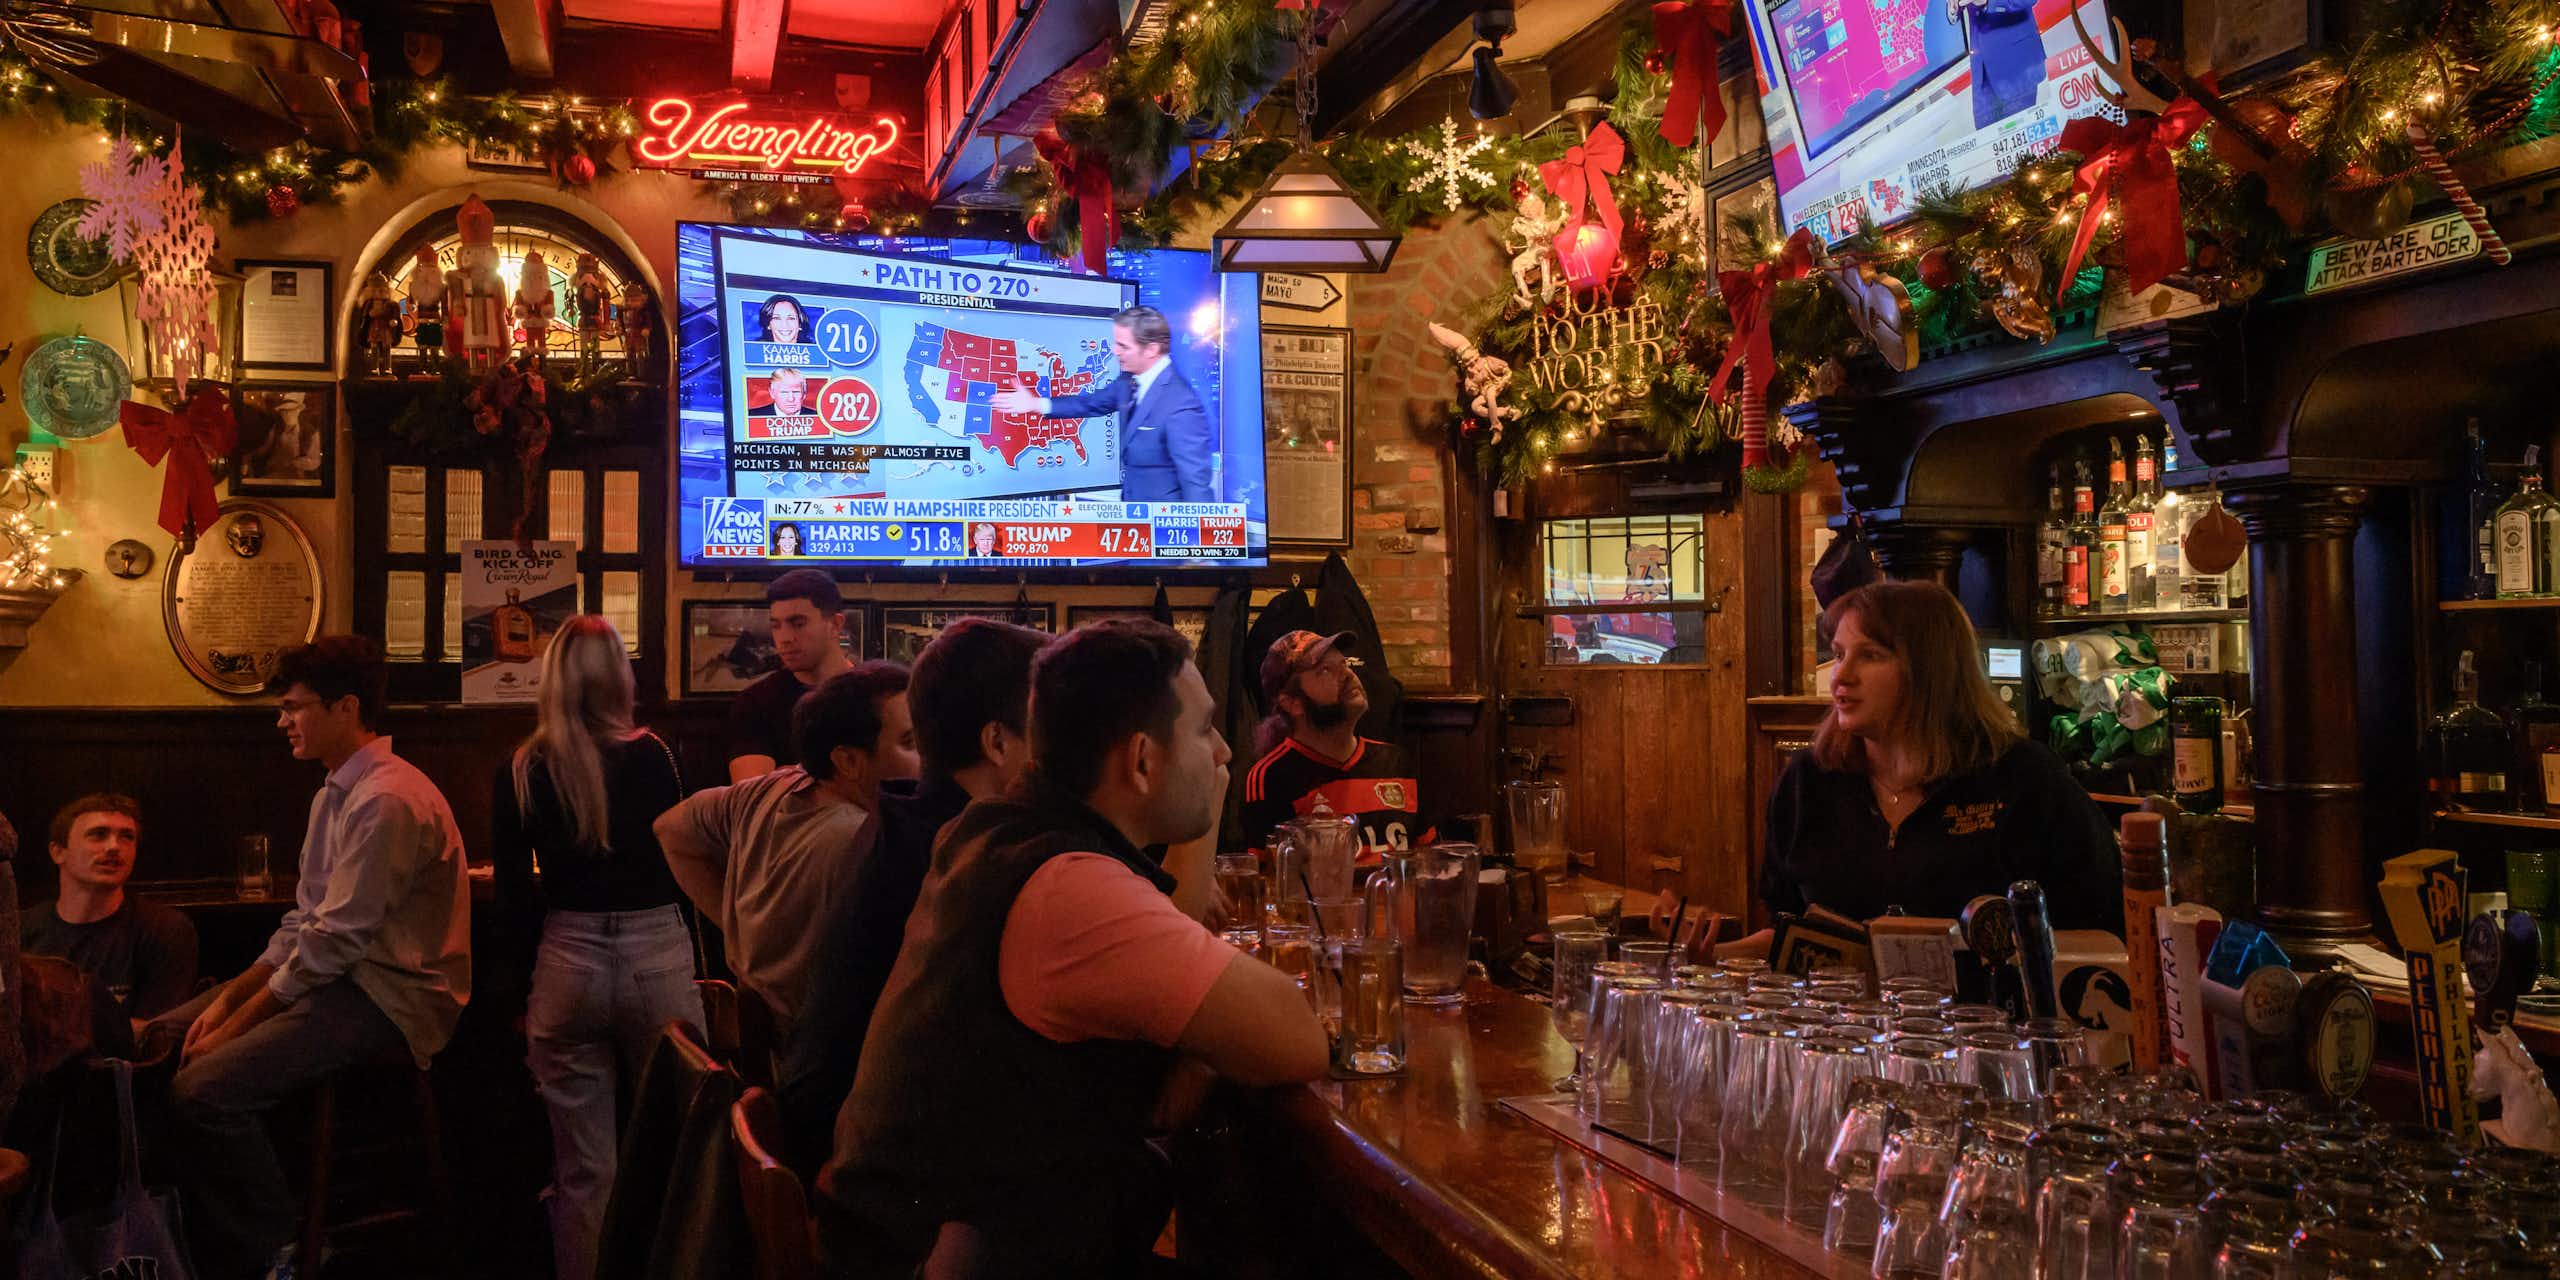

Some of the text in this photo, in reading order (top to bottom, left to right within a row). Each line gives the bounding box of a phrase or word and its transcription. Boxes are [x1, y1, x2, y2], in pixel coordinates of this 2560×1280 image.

[2058, 46, 2090, 70] LIVE
[2059, 67, 2101, 109] CNN
[640, 99, 897, 174] Yuengling
[1907, 148, 1947, 174] MINNESOTA
[704, 170, 819, 184] AMERICA'S OLDEST BREWERY
[1919, 163, 1950, 186] HARRIS
[1804, 198, 1834, 219] ELECTORAL
[1834, 191, 1848, 204] MAP
[2325, 218, 2462, 267] BEWARE OF
[2313, 235, 2471, 287] ATTACK BARTENDER
[876, 263, 1030, 298] PATH TO 270
[1266, 285, 1329, 299] MAYO 5
[919, 292, 996, 309] PRESIDENTIAL
[826, 322, 868, 354] 216
[1534, 303, 1664, 358] TO THE
[763, 344, 811, 356] KAMALA
[763, 354, 811, 366] HARRIS
[1295, 375, 1341, 387] CULTURE
[828, 393, 871, 422] 282
[765, 417, 815, 429] DONALD
[768, 427, 812, 437] TRUMP
[734, 444, 964, 459] MICHIGAN, HE WAS UP ALMOST FIVE
[734, 459, 870, 471] POINTS IN MICHIGAN
[850, 501, 887, 517] NEW
[893, 502, 986, 519] HAMPSHIRE
[989, 503, 1058, 518] PRESIDENT
[1078, 504, 1123, 512] ELECTORAL
[1096, 511, 1123, 519] VOTES
[1132, 505, 1141, 518] 4
[1170, 505, 1230, 515] PRESIDENT
[725, 511, 762, 528] FOX
[1156, 517, 1243, 528] HARRIS TRUMP
[713, 528, 764, 544] NEWS
[810, 525, 881, 542] HARRIS
[1006, 526, 1072, 543] TRUMP
[1167, 529, 1234, 545] 216 232
[474, 550, 512, 559] BIRD
[711, 546, 758, 556] LIVE
[810, 542, 855, 553] 329,413
[1006, 543, 1049, 554] 299,870
[1159, 548, 1239, 557] NEEDED TO WIN: 270
[483, 560, 555, 569] KICK OFF
[486, 569, 550, 585] Crown Royal
[2161, 936, 2185, 1040] ULTRA
